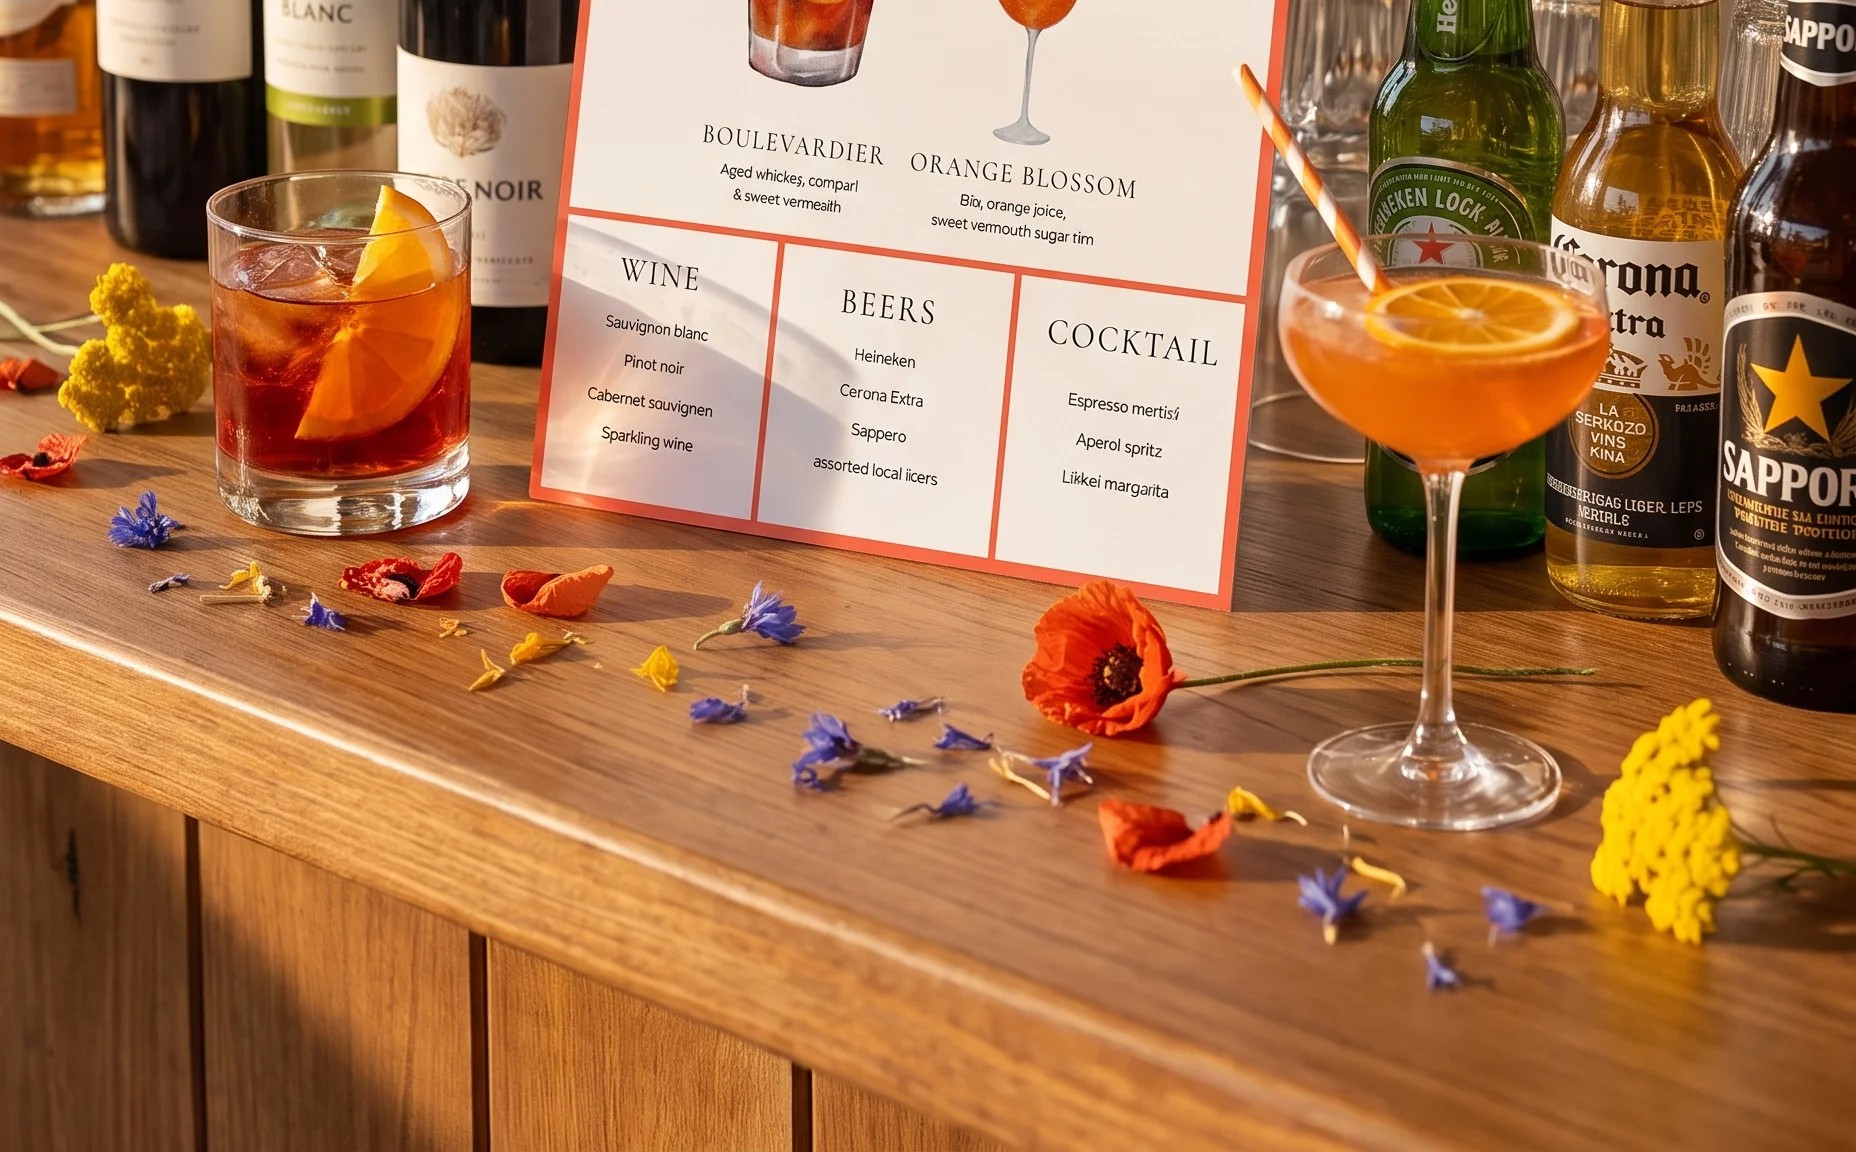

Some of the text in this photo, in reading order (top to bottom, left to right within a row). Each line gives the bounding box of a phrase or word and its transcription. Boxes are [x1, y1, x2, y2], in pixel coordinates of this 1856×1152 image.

[1783, 14, 1856, 54] SAPPO
[702, 124, 884, 166] BOULEVARDIER
[720, 163, 753, 180] Aged
[910, 152, 1136, 199] ORANGE BLOSSOM
[475, 180, 544, 202] NOIR
[733, 188, 742, 201] &
[744, 191, 781, 206] sweet
[986, 199, 1030, 217] orange
[931, 215, 969, 230] sweet
[970, 221, 1031, 238] vermouth
[1034, 228, 1069, 245] sugar
[621, 257, 700, 291] WINE
[841, 289, 935, 325] BEERS
[606, 315, 709, 342] Sauvignon blanc
[1048, 319, 1218, 366] COCKTAIL
[624, 354, 685, 375] Pinot noir
[854, 348, 916, 368] Heineken
[587, 386, 646, 408] Cabernet
[890, 390, 924, 408] Extra
[1068, 392, 1129, 414] Espresso
[1599, 402, 1619, 418] LA
[601, 426, 694, 452] Sparkling wine
[851, 422, 907, 443] Sappero
[1591, 431, 1626, 449] VINS
[1076, 433, 1163, 458] Aperol spritz
[1590, 446, 1625, 463] KINA
[813, 457, 869, 475] assorted
[872, 463, 902, 481] local
[1104, 477, 1169, 498] margarita
[1671, 500, 1703, 514] LEPS
